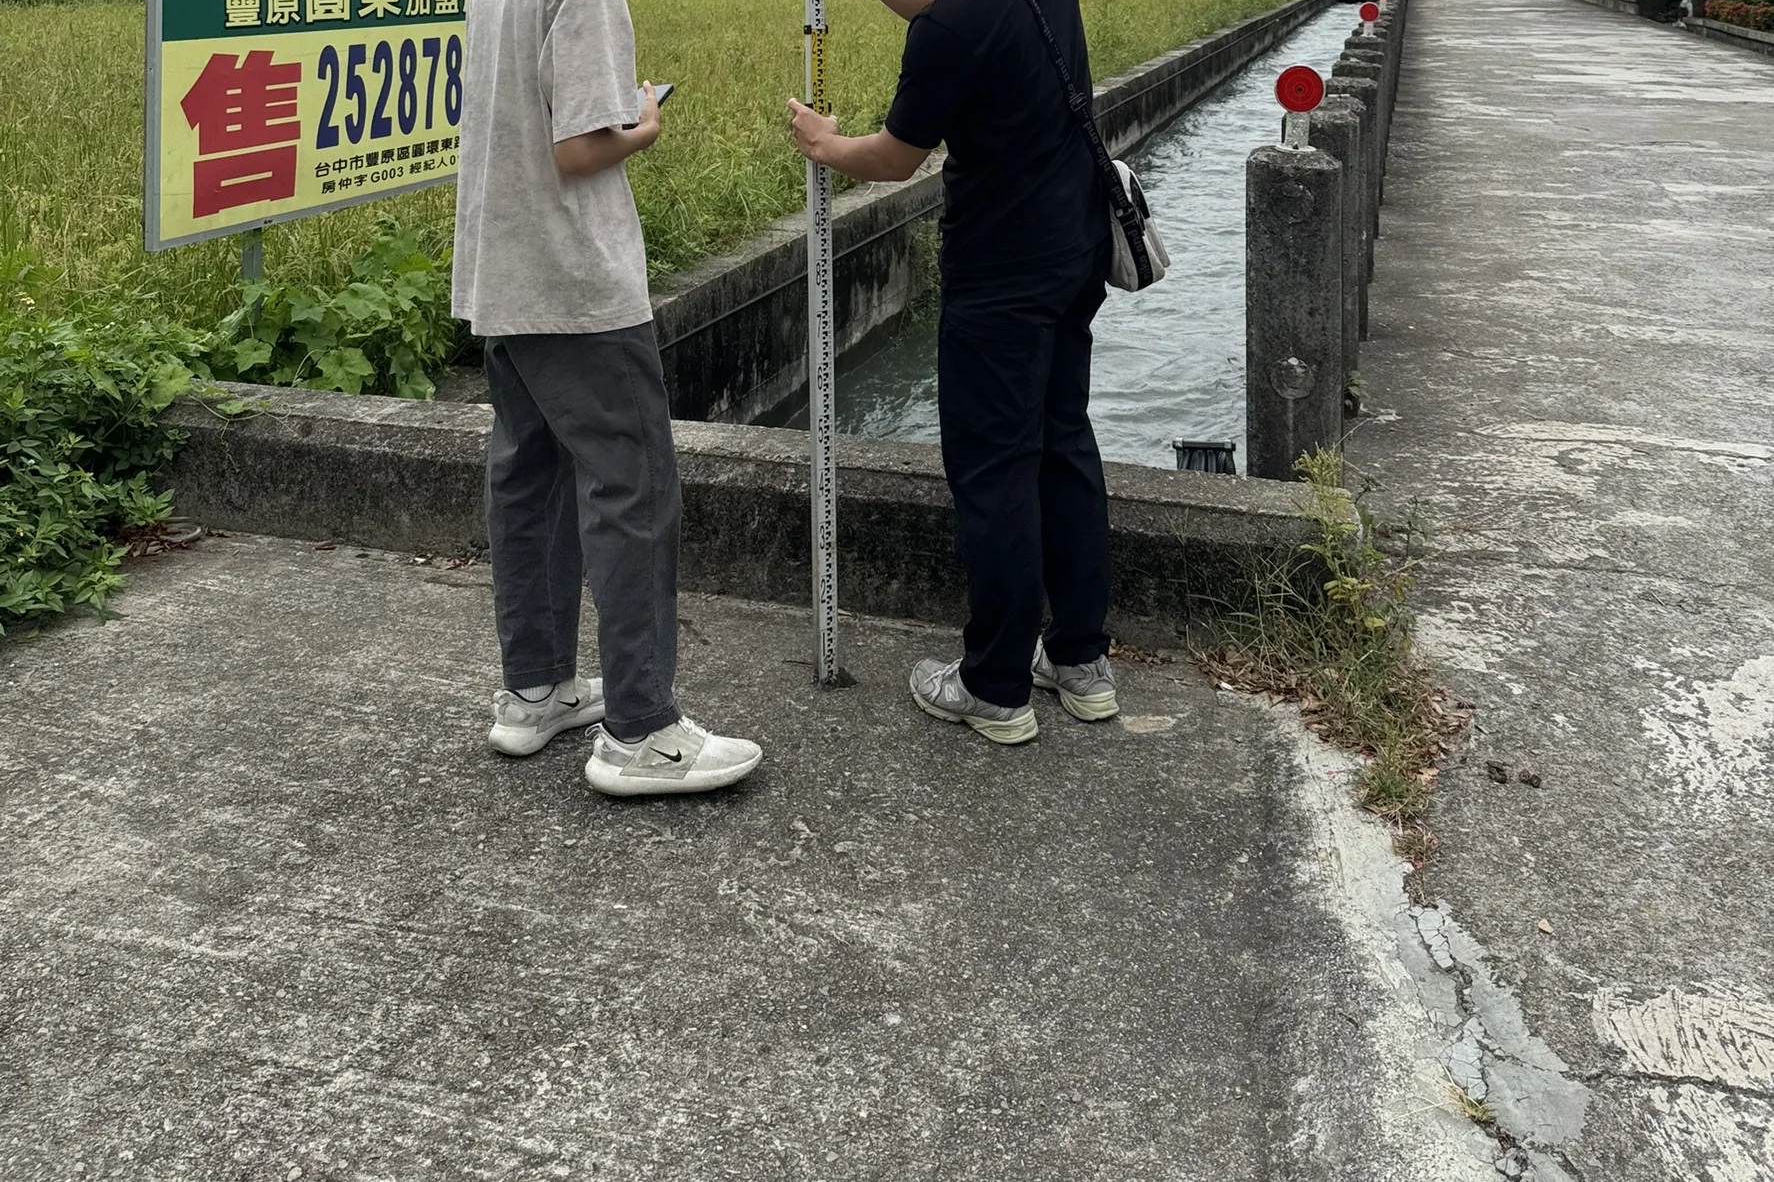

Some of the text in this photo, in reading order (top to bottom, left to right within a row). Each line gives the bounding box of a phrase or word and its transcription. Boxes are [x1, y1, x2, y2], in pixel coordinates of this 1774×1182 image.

[1054, 56, 1071, 82] and
[316, 34, 463, 150] 252878
[180, 50, 302, 218] 售
[1082, 119, 1100, 145] and
[409, 155, 460, 175] 經紀人0
[1096, 144, 1113, 173] niko
[1110, 184, 1129, 208] and
[944, 683, 960, 703] N
